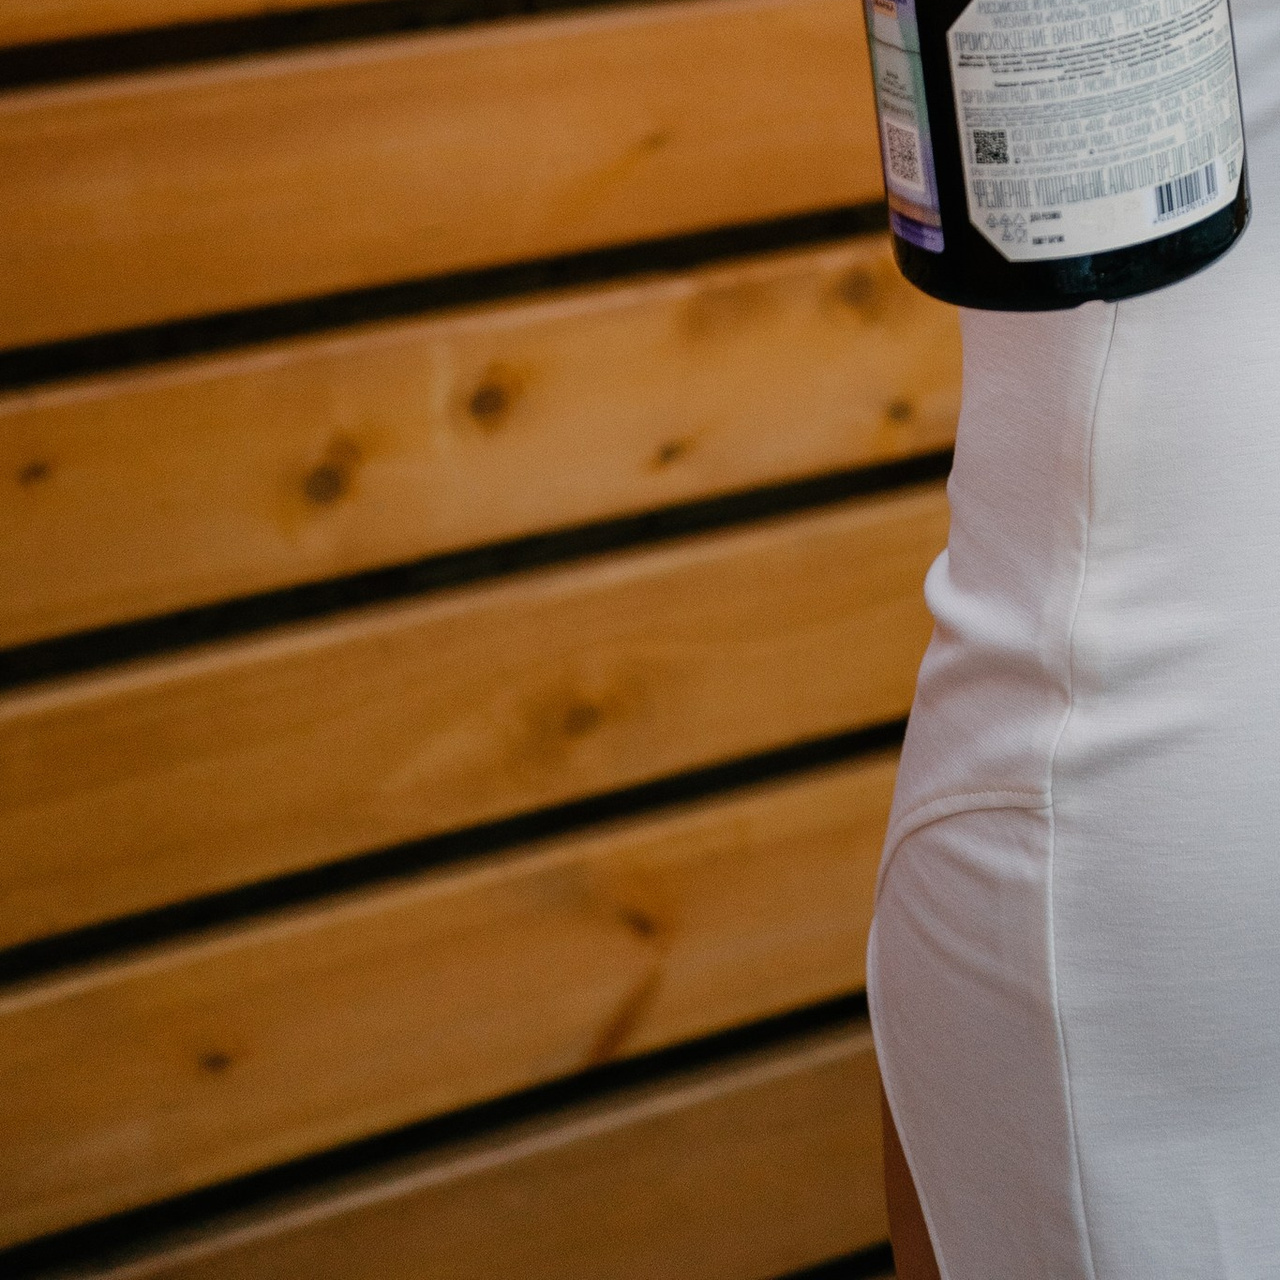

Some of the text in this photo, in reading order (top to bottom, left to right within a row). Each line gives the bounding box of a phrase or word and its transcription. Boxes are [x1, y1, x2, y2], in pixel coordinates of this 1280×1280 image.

[955, 26, 1048, 51] ПРОИСХОЖДЕНИЕ
[1052, 16, 1114, 43] ВИНОГРАДА
[973, 176, 1034, 208] ЧРЕЗМЕРНОЕ
[1034, 169, 1106, 204] УПОТРЕБЛЕНИЕ
